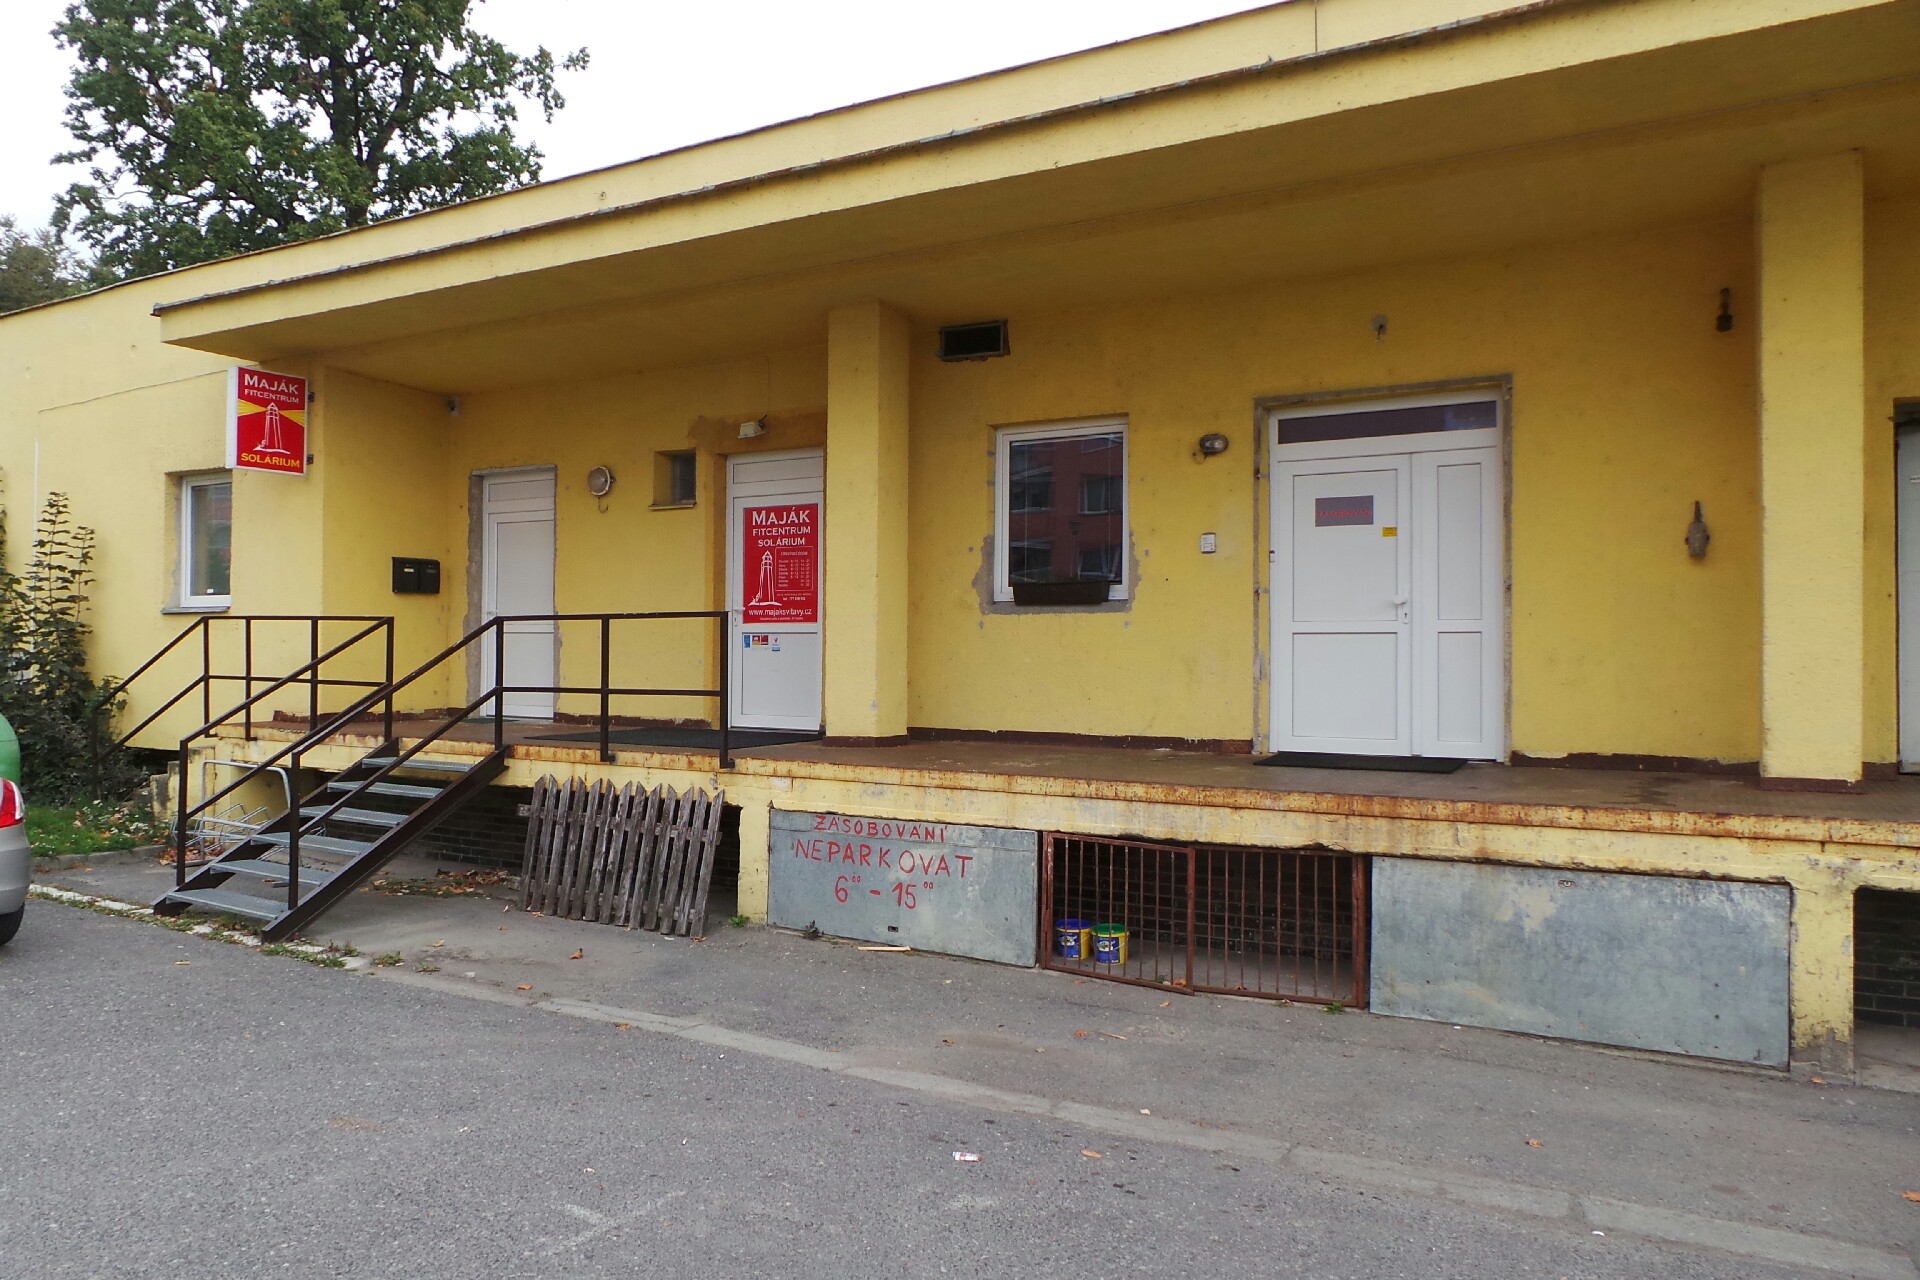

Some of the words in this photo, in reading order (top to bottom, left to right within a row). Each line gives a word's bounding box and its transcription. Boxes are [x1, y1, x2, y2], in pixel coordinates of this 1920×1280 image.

[245, 388, 299, 403] FITCENTRUM
[241, 453, 300, 468] SOLÁRIUM
[752, 526, 811, 537] FITCENTRUM
[758, 537, 806, 547] SOLÁRIUM
[795, 838, 974, 879] NEPARKOVAT
